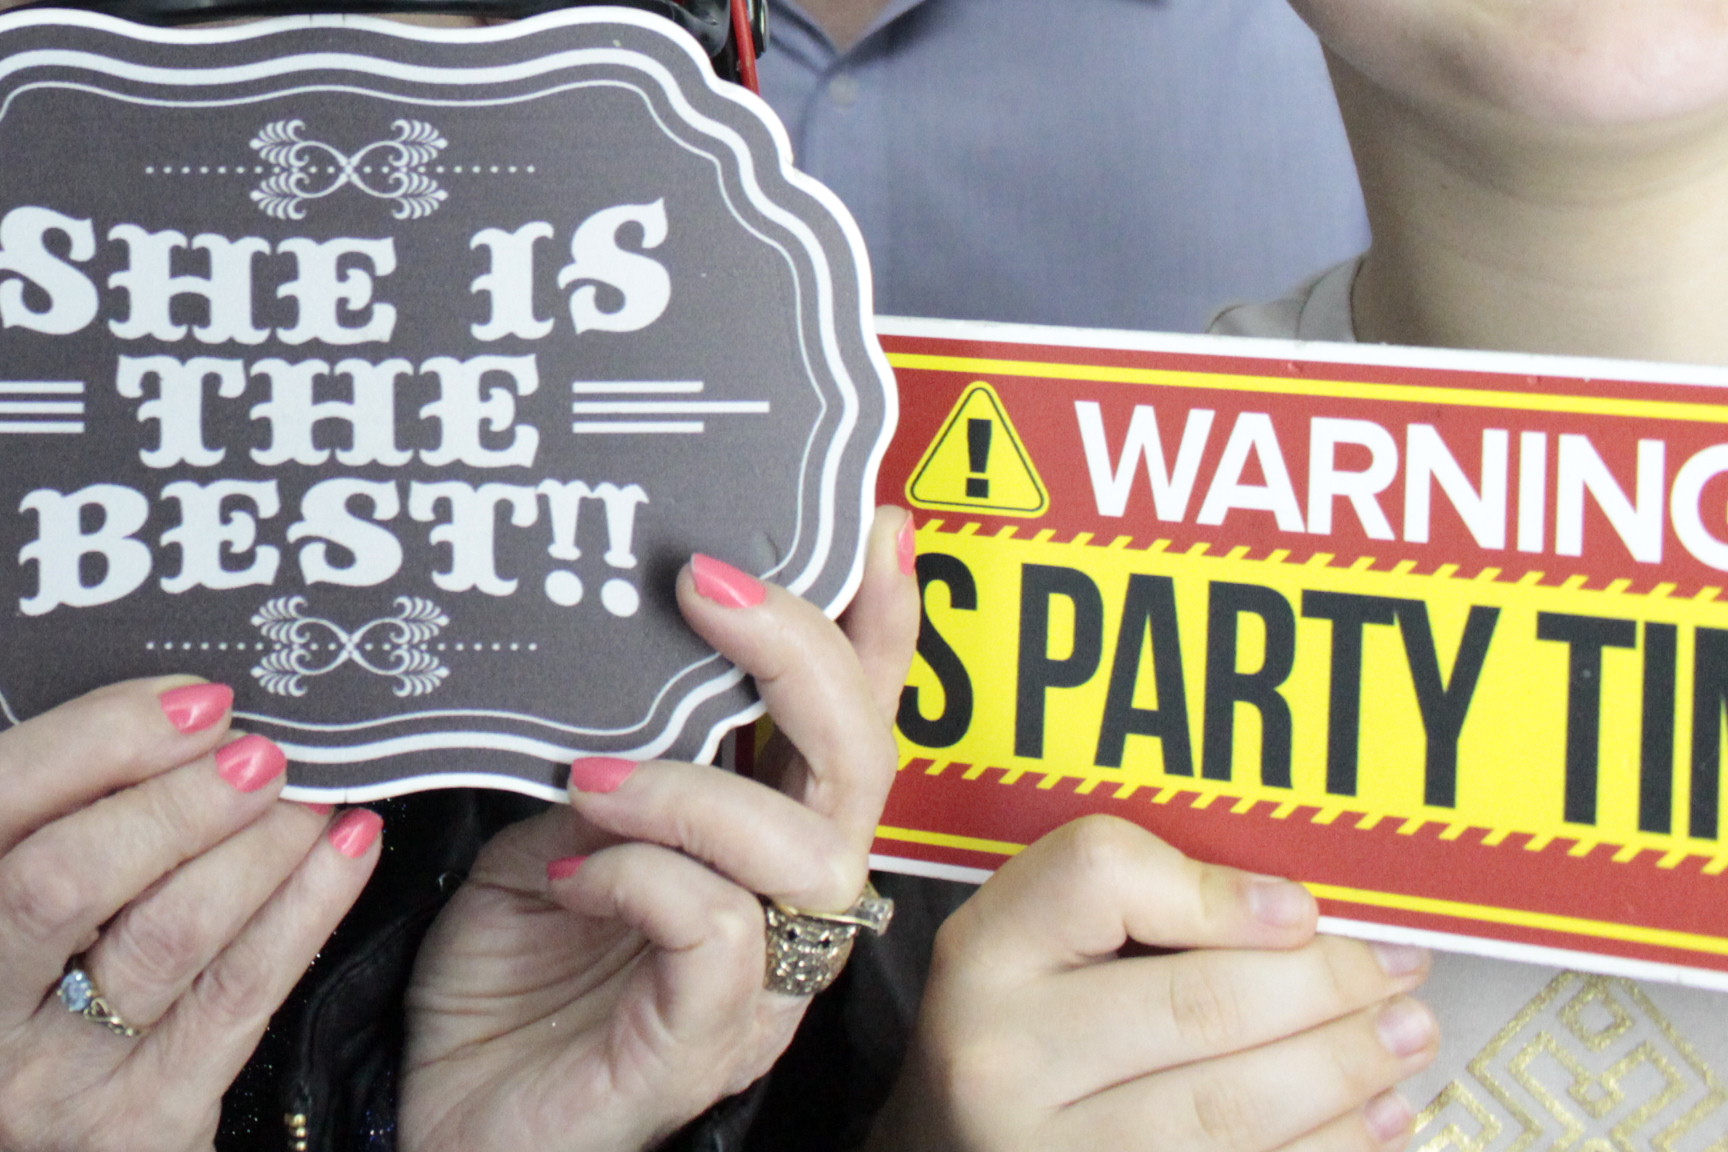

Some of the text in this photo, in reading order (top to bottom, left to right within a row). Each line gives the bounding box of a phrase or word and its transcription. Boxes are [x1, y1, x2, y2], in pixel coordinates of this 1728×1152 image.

[469, 196, 672, 341] IS
[116, 353, 540, 469] THE
[18, 477, 649, 618] BEST!!
[1014, 562, 1502, 809] PARTY
